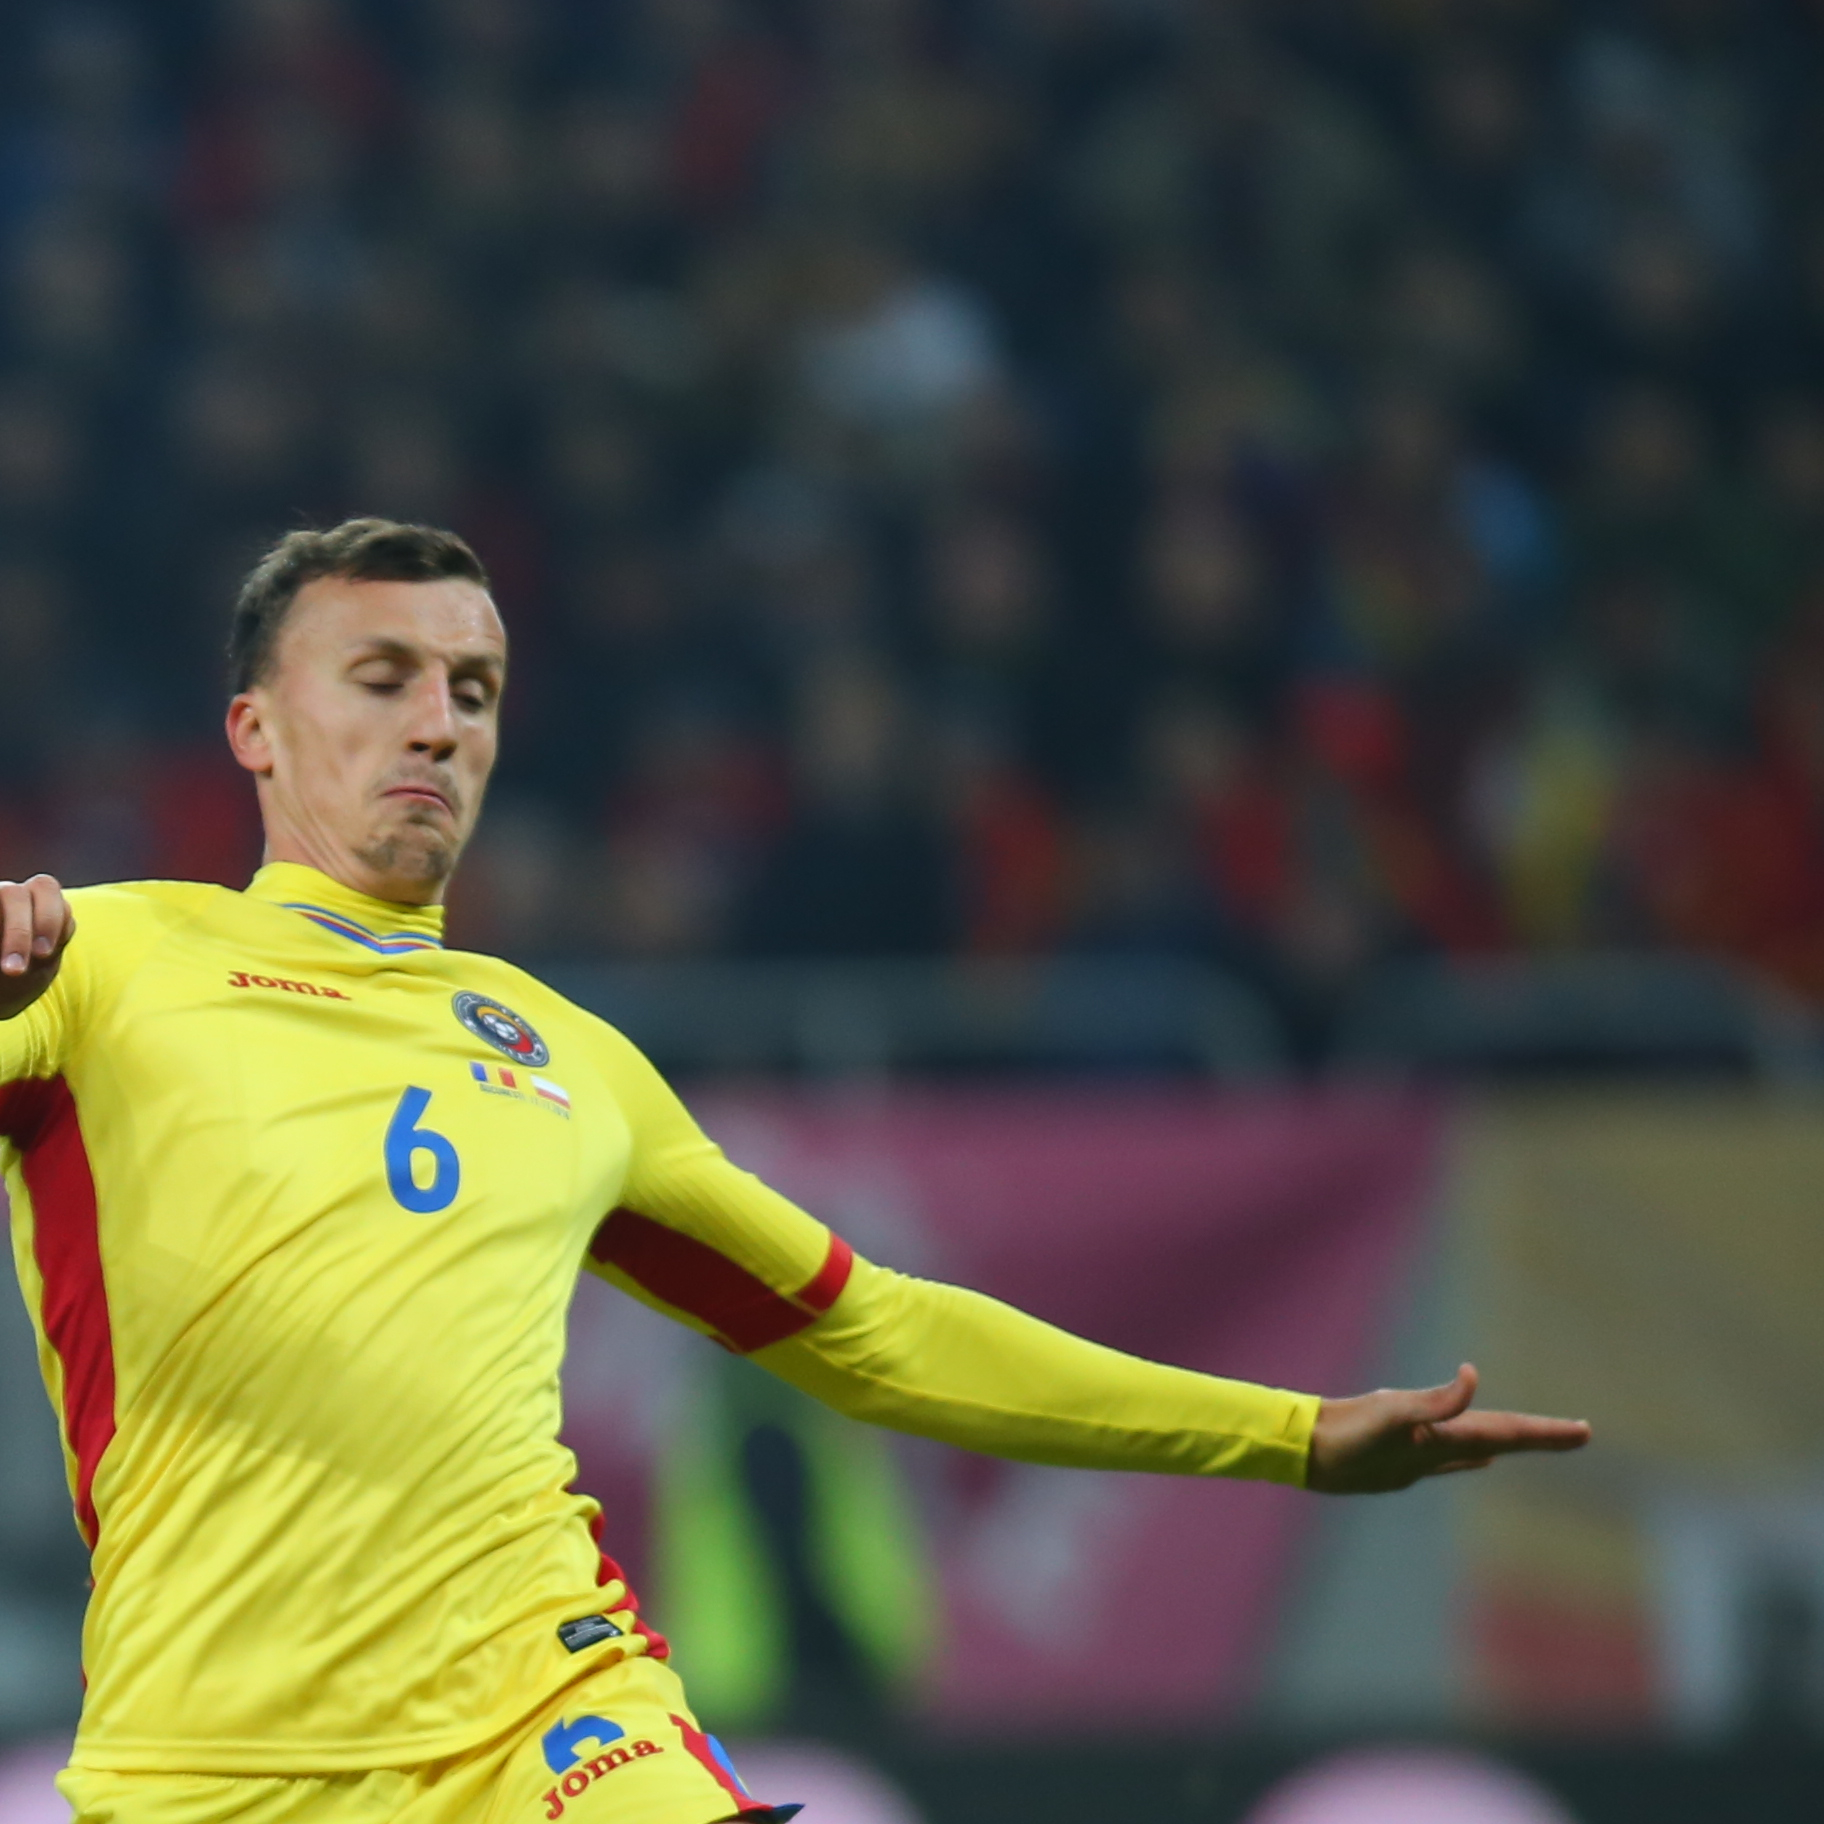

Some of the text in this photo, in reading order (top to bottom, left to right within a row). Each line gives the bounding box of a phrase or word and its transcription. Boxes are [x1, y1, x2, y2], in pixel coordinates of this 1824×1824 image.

[227, 970, 351, 1001] Joma
[384, 1084, 460, 1213] 6
[542, 1739, 664, 1821] Joma
